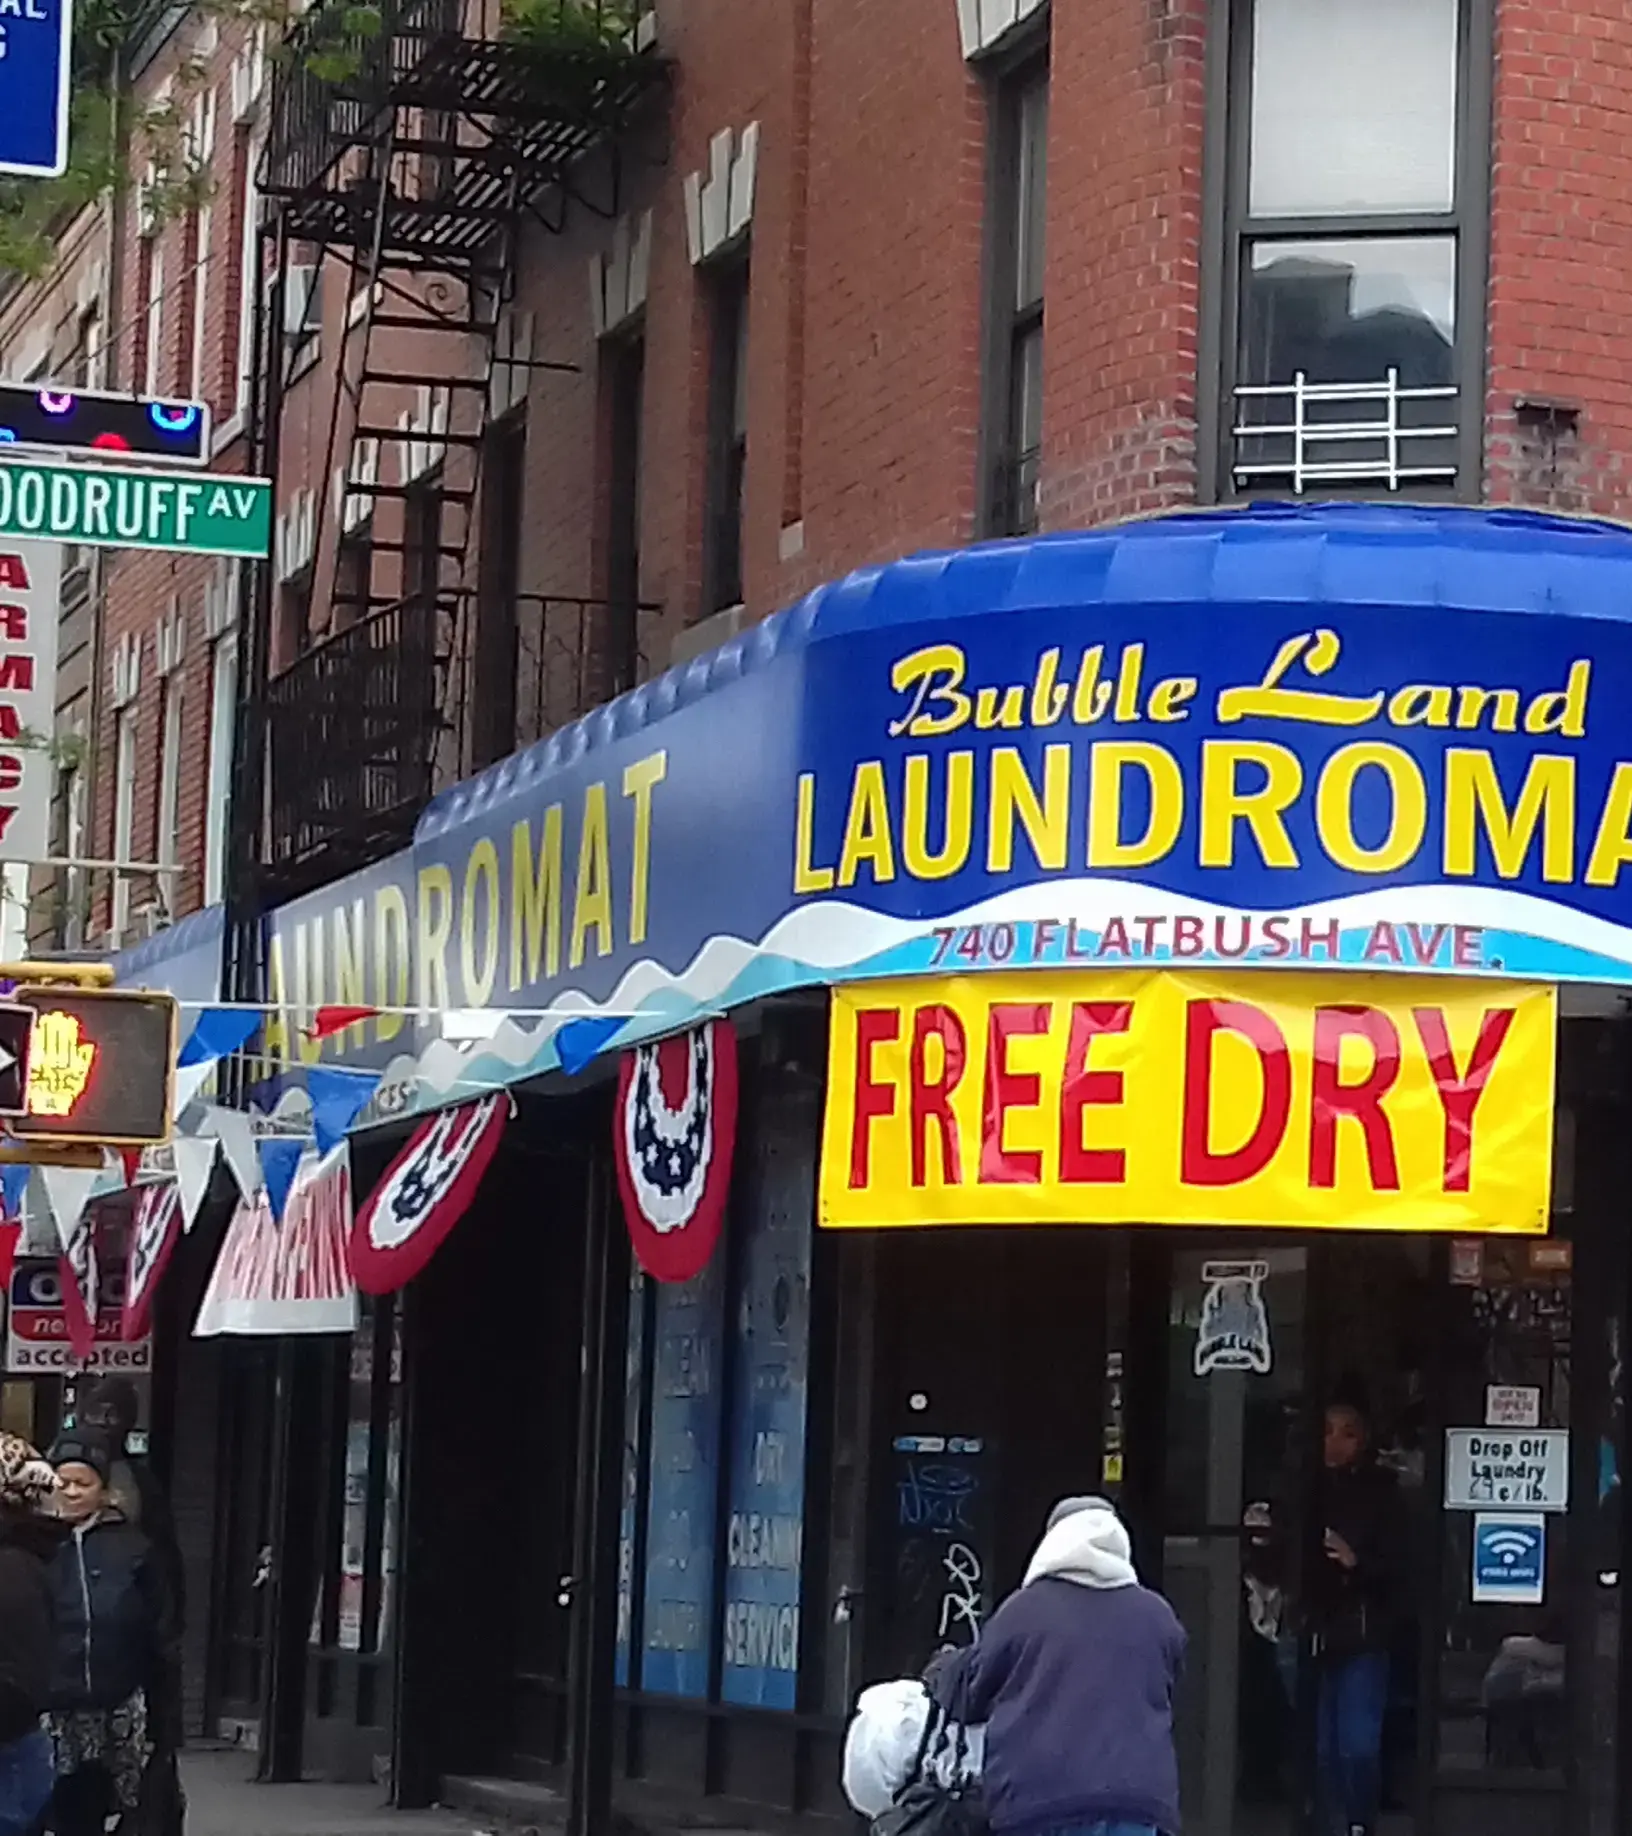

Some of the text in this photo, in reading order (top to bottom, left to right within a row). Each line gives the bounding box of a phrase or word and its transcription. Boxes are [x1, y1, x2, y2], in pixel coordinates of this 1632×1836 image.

[207, 486, 257, 519] AV
[888, 628, 1592, 738] Bubble Land
[252, 748, 668, 1080] AUNDROMAT
[930, 925, 1016, 966] 740
[1032, 914, 1341, 960] FLATBUSH
[848, 997, 1518, 1194] FREE DRY
[16, 1345, 150, 1372] accepted
[1469, 1437, 1549, 1461] Drop Off
[1470, 1461, 1546, 1484] Laundry
